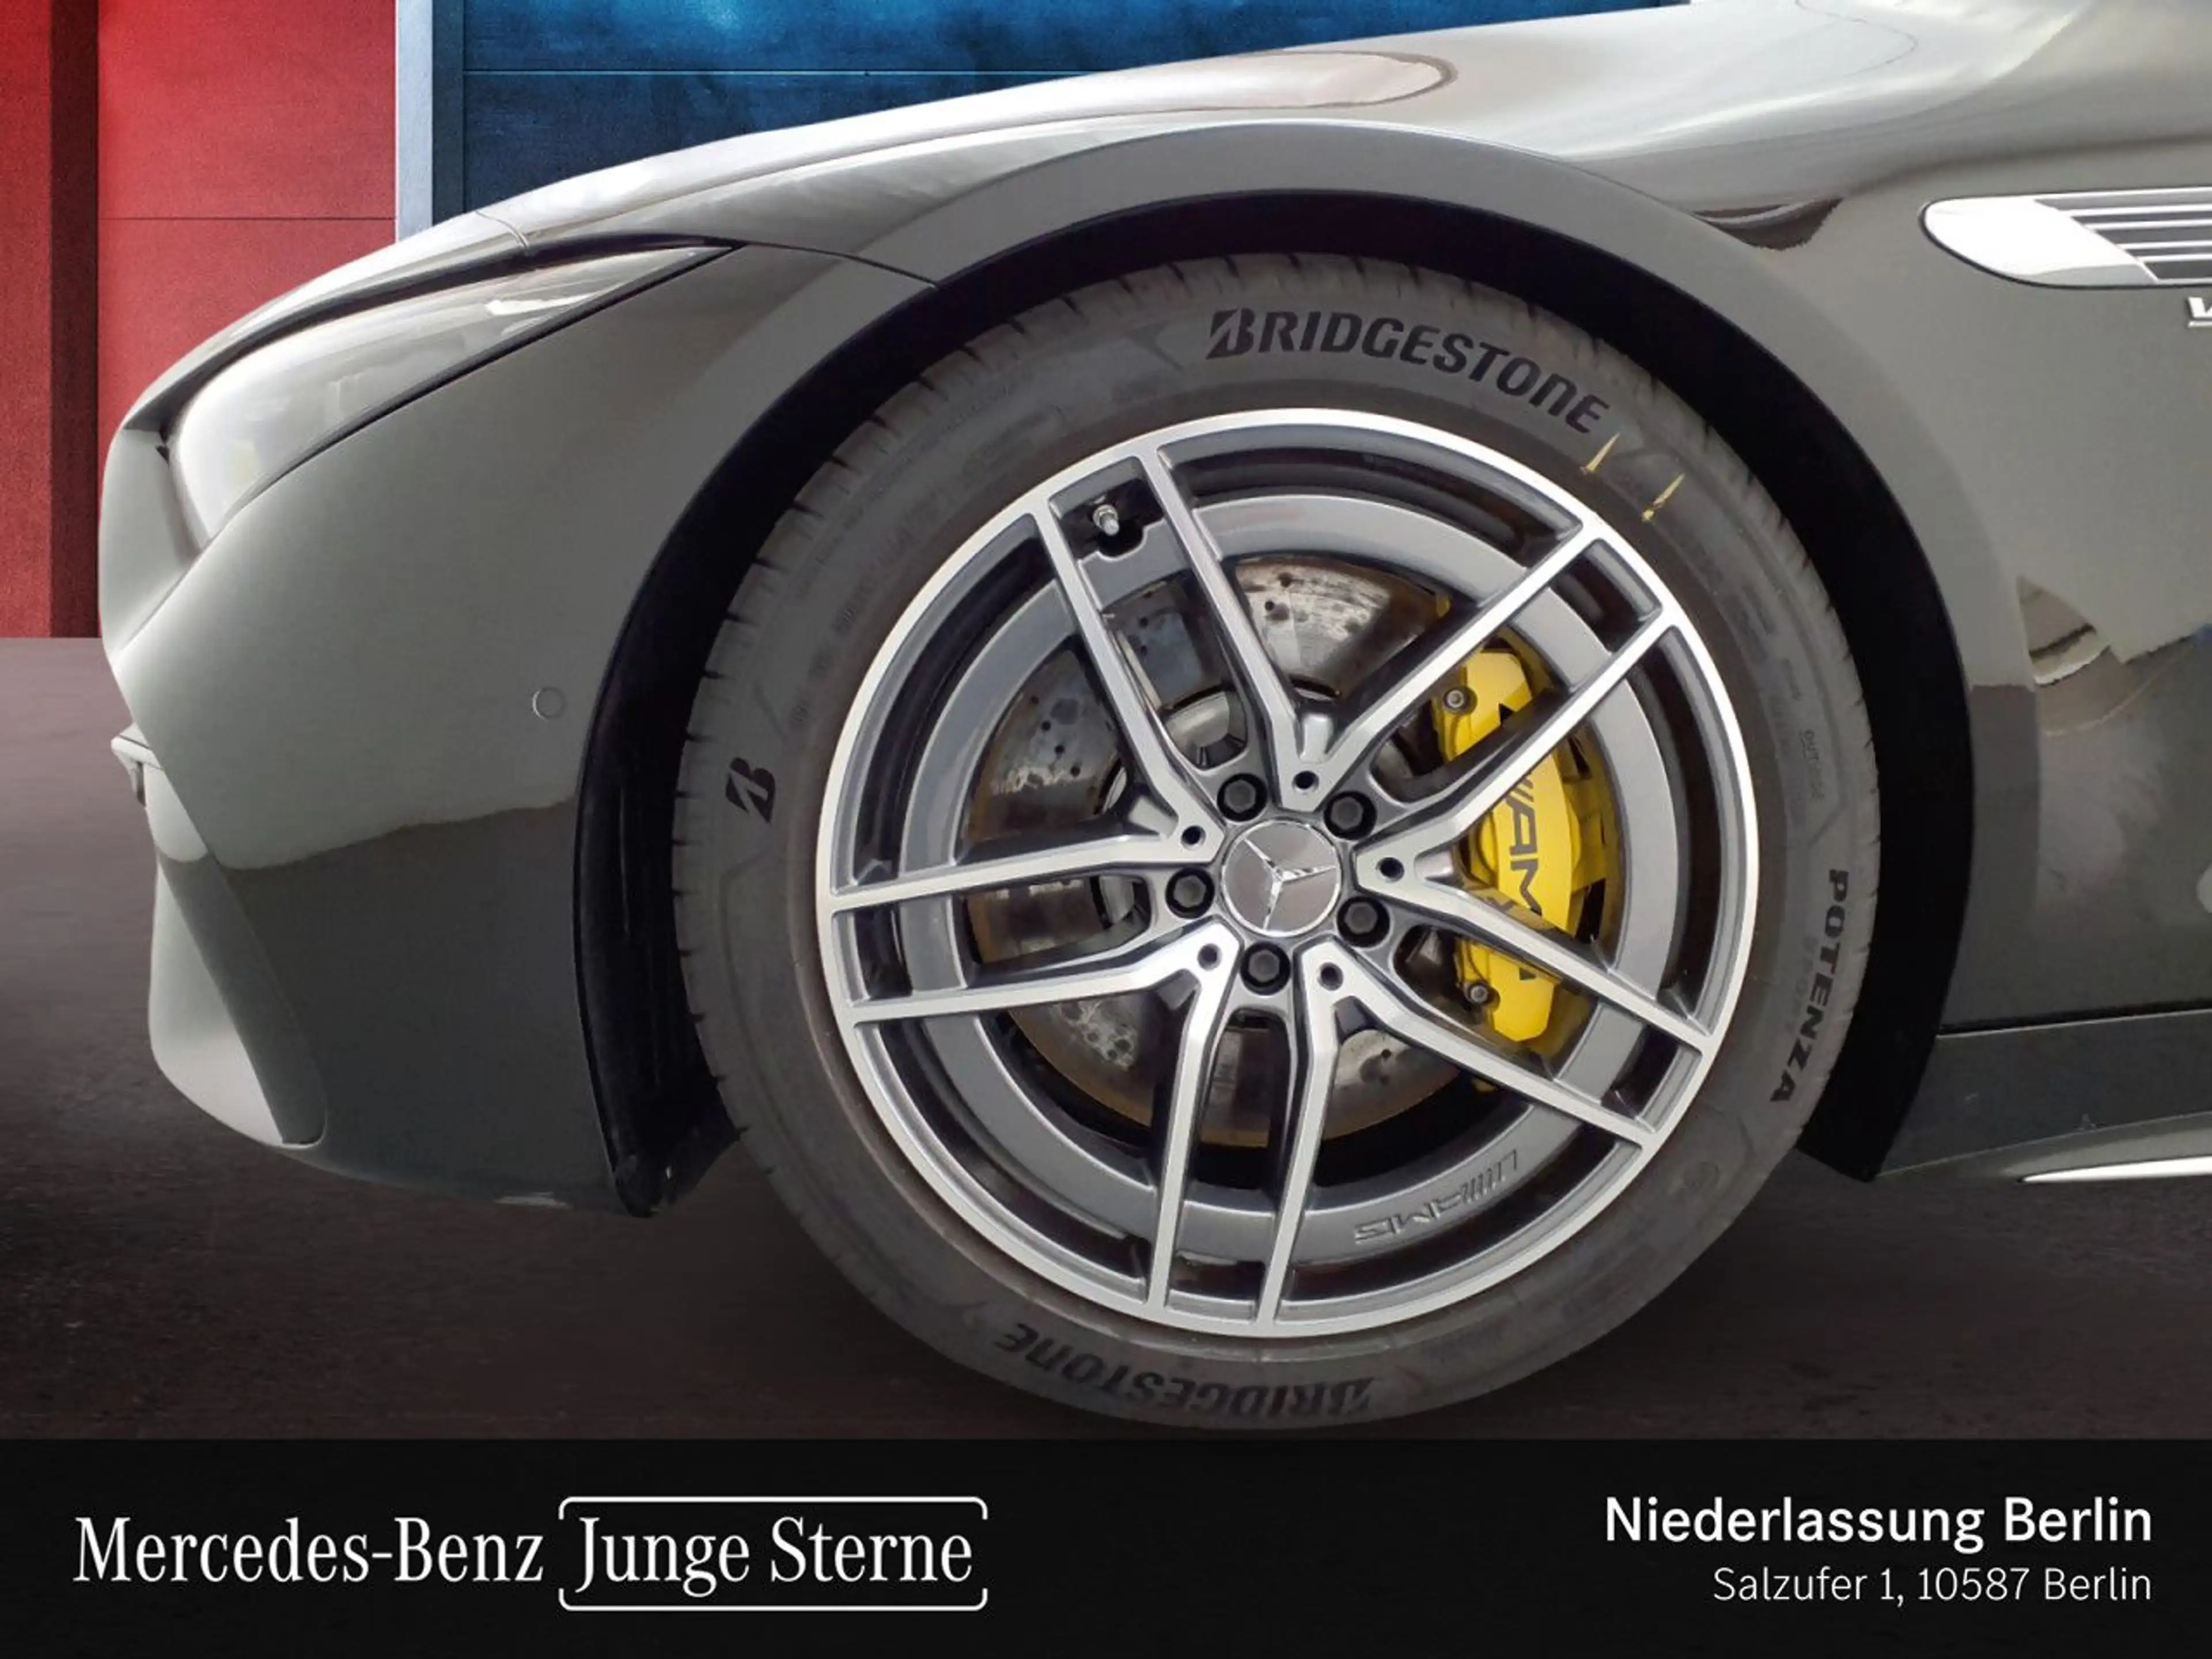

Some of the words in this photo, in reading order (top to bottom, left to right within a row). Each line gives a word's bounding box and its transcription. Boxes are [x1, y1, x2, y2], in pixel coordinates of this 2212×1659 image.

[1206, 308, 1609, 434] BRIDGESTONE
[1770, 869, 1849, 1103] POTENZA
[993, 1323, 1376, 1417] BRIDGESTONE
